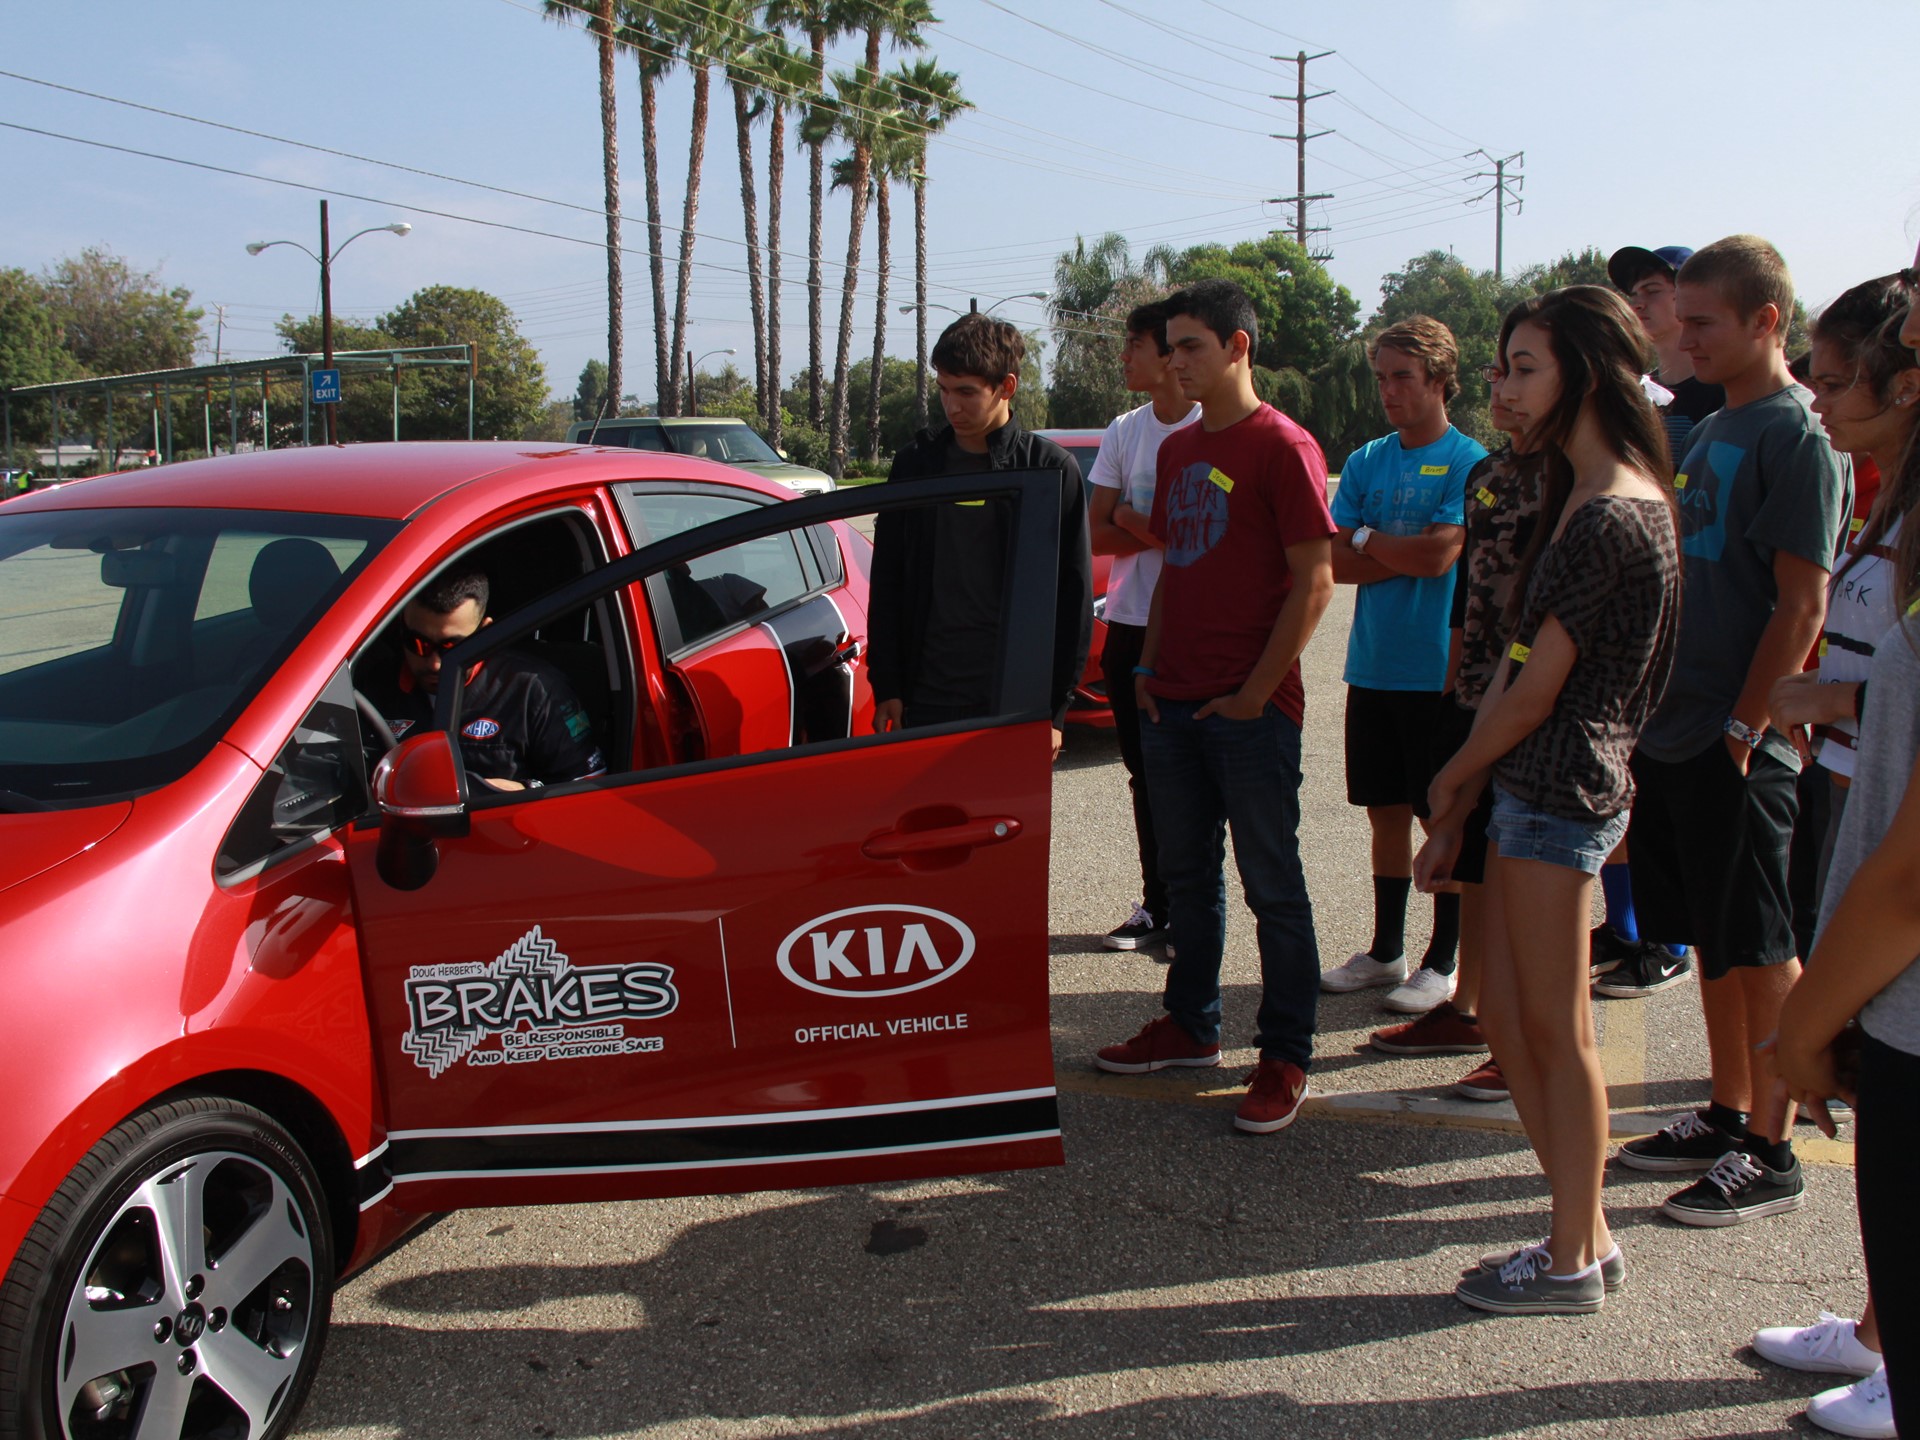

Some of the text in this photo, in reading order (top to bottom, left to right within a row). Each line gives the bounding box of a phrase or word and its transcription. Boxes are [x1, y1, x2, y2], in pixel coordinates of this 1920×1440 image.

[315, 388, 337, 399] EXIT
[465, 720, 497, 737] NHRA
[808, 923, 944, 981] KIA
[412, 964, 483, 978] DOUG HERBERT'S
[414, 970, 672, 1029] BRAKES
[504, 1027, 622, 1047] BE RESPONSIBLE
[794, 1013, 969, 1044] OFFICIAL VEHICLE
[470, 1039, 662, 1064] AND KEEP EVERYONE SAFE
[178, 1314, 203, 1335] KIA
